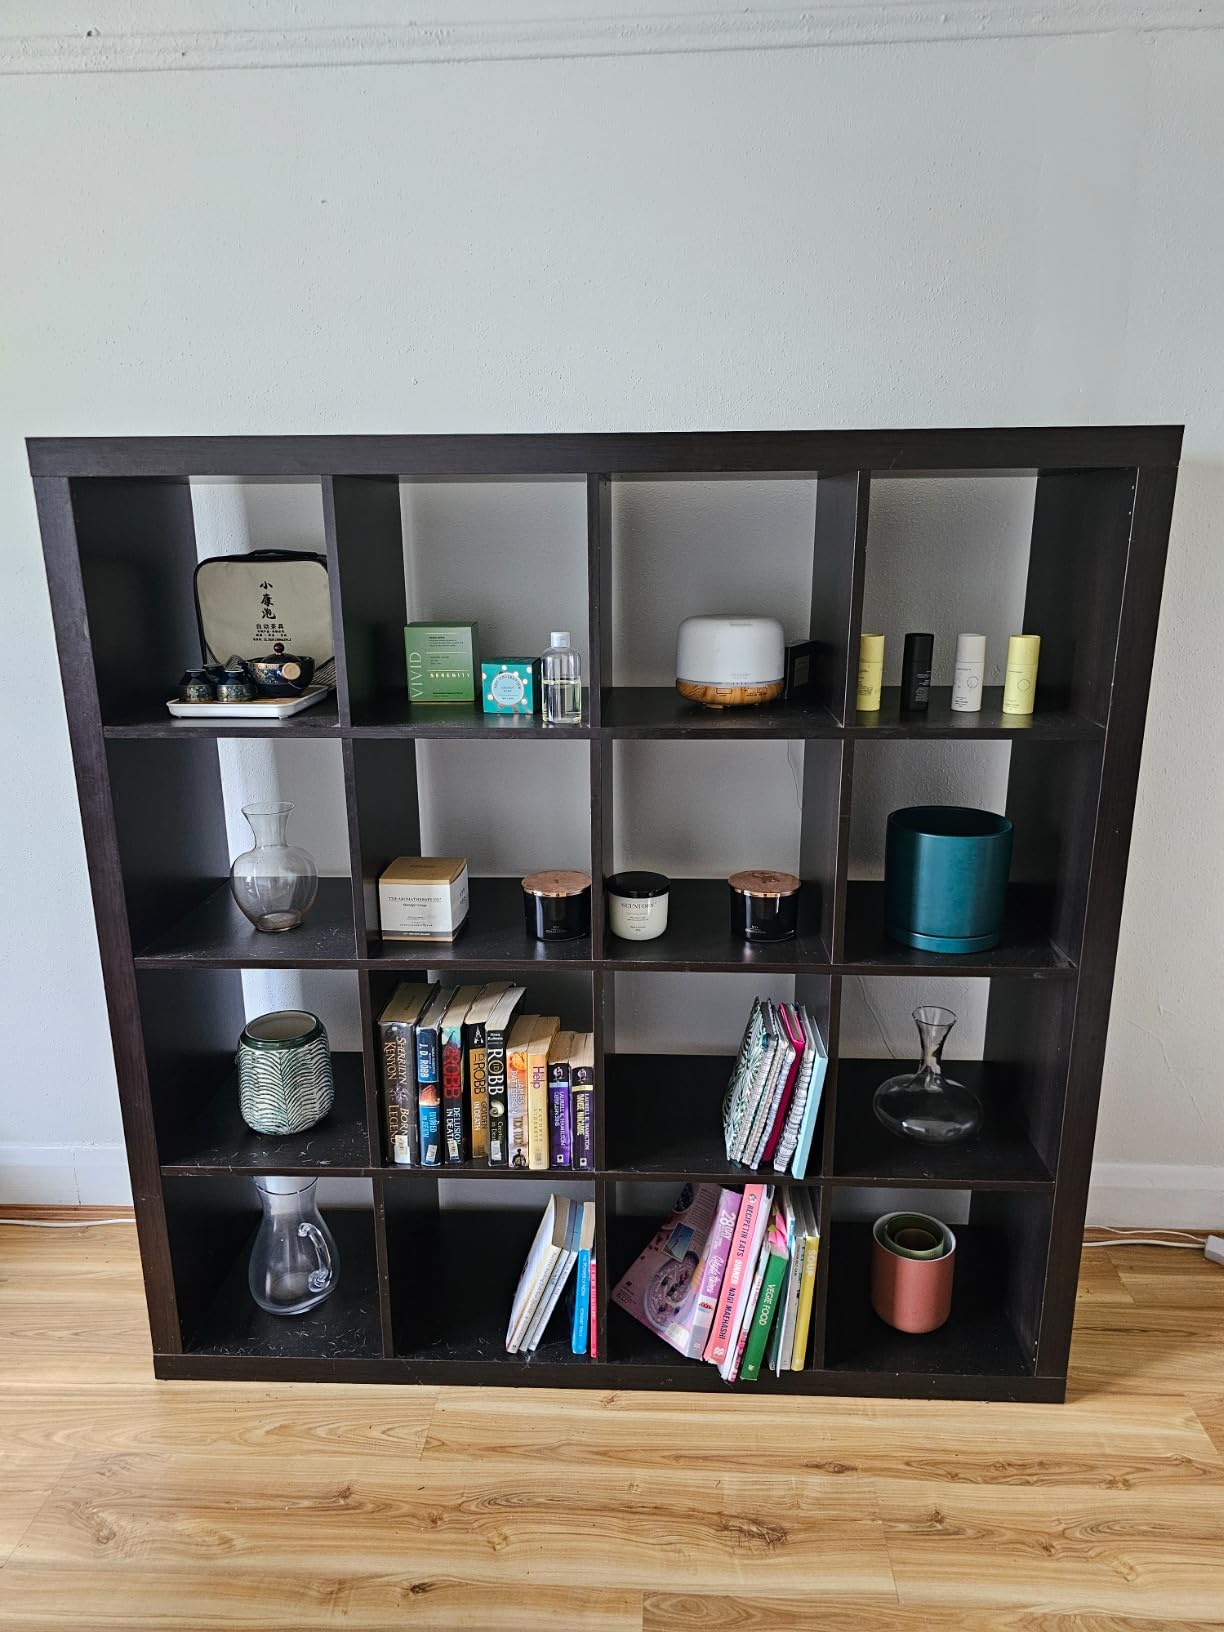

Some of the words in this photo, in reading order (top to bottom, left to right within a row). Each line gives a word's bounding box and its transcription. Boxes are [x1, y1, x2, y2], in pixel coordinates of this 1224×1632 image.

[409, 652, 424, 698] VIVID
[383, 1041, 397, 1080] KENYON
[395, 1036, 408, 1085] SHERRILYN
[420, 1060, 430, 1078] ROBB
[473, 1062, 486, 1095] ROBB
[530, 1066, 545, 1089] Help
[511, 1070, 519, 1114] PATTERSON
[517, 1081, 525, 1105] JAMES
[388, 1104, 401, 1145] LEGEND
[400, 1107, 410, 1136] BORN
[446, 1108, 454, 1117] IN
[473, 1110, 481, 1131] DEATH
[480, 1101, 488, 1130] GOLDEN
[719, 1209, 737, 1227] 28
[740, 1204, 754, 1239] RECIPETIN
[736, 1240, 747, 1257] EATS
[730, 1258, 743, 1286] DINNER
[805, 1249, 817, 1279] SOUP
[726, 1287, 737, 1303] NAGI
[763, 1284, 776, 1305] VEGIE
[718, 1304, 733, 1340] MAEHASHI
[758, 1305, 771, 1326] FOOD
